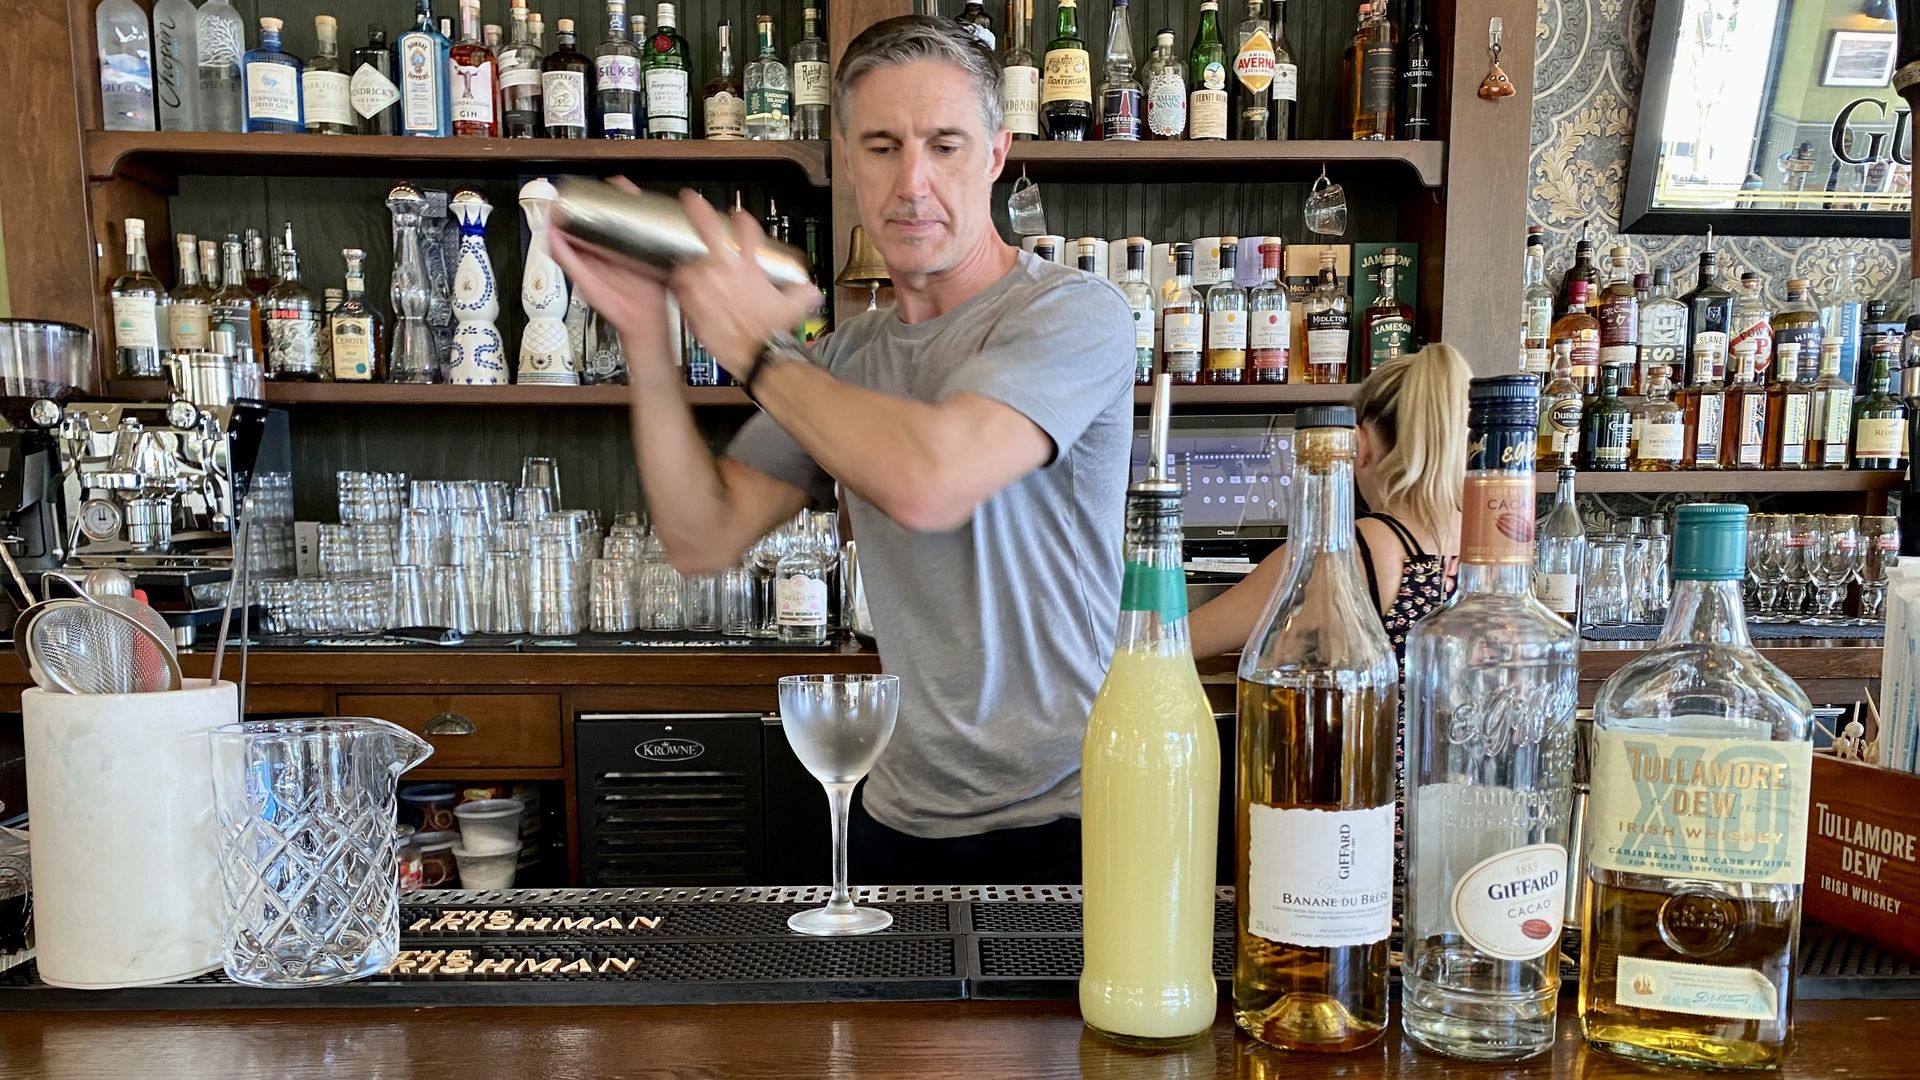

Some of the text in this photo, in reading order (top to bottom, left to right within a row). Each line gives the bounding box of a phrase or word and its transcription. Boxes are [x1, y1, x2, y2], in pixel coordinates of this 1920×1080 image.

[156, 16, 180, 108] Chopin
[1238, 56, 1275, 70] AVERNA
[600, 66, 634, 78] SILKS
[1312, 314, 1347, 324] MIDLETON
[1374, 324, 1412, 335] JAMESON
[1699, 334, 1724, 345] SLANE
[643, 741, 697, 756] KROWNE
[1627, 748, 1788, 790] TULLAMORE
[1618, 822, 1784, 844] IRISH WHISKEY
[1816, 802, 1917, 862] TULLAMORE
[1338, 824, 1351, 880] GIFFARD
[1608, 847, 1678, 861] CARIBBEAN
[1713, 858, 1744, 866] CASK
[1516, 863, 1538, 876] 1885
[1488, 870, 1559, 900] GIFFARD
[1282, 892, 1337, 908] BANANE
[1820, 875, 1901, 915] IRISH WHISKEY
[1508, 900, 1551, 919] CACAO
[409, 916, 662, 931] IRISHMAN
[378, 958, 636, 974] RISHMAN
